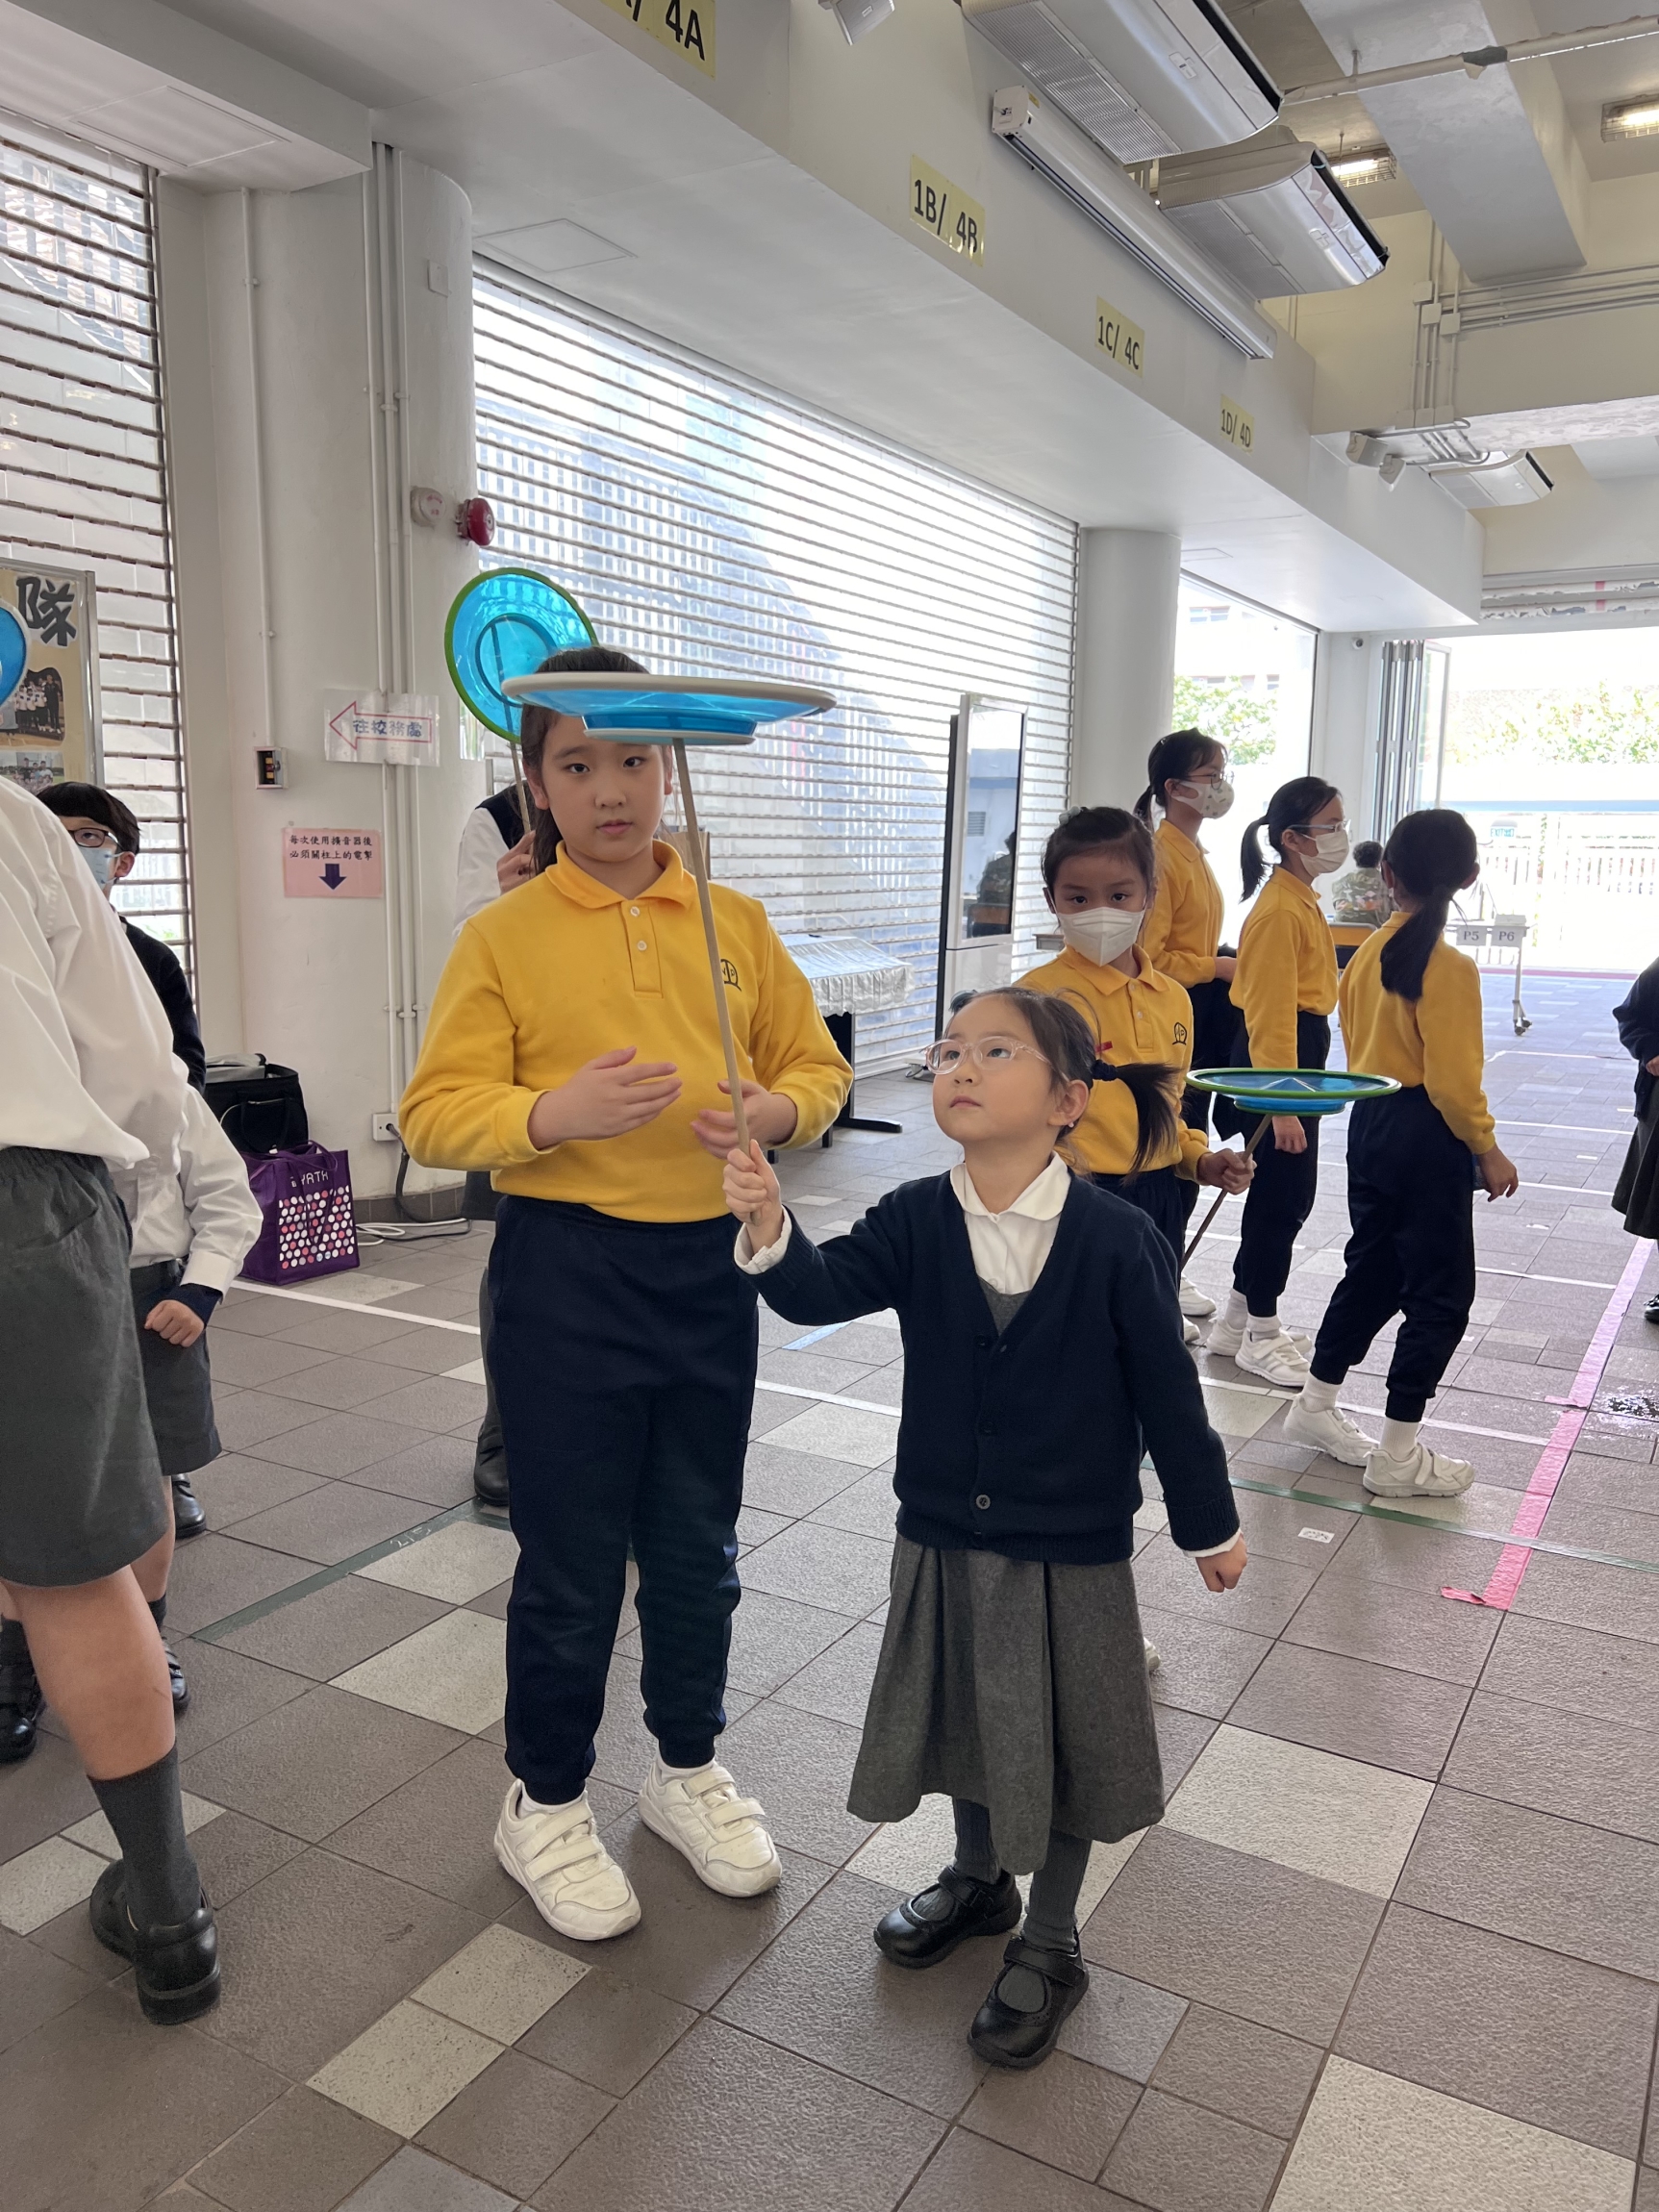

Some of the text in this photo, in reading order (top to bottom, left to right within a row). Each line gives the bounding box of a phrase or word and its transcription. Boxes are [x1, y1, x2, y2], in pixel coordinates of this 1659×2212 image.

[666, 0, 705, 61] 4A
[915, 179, 946, 236] 1B/
[1097, 315, 1140, 370] 1C/ 4C
[1221, 409, 1251, 448] 1D/ 4D
[15, 575, 77, 646] 隊
[1463, 930, 1479, 942] P5
[1498, 930, 1515, 942] P6
